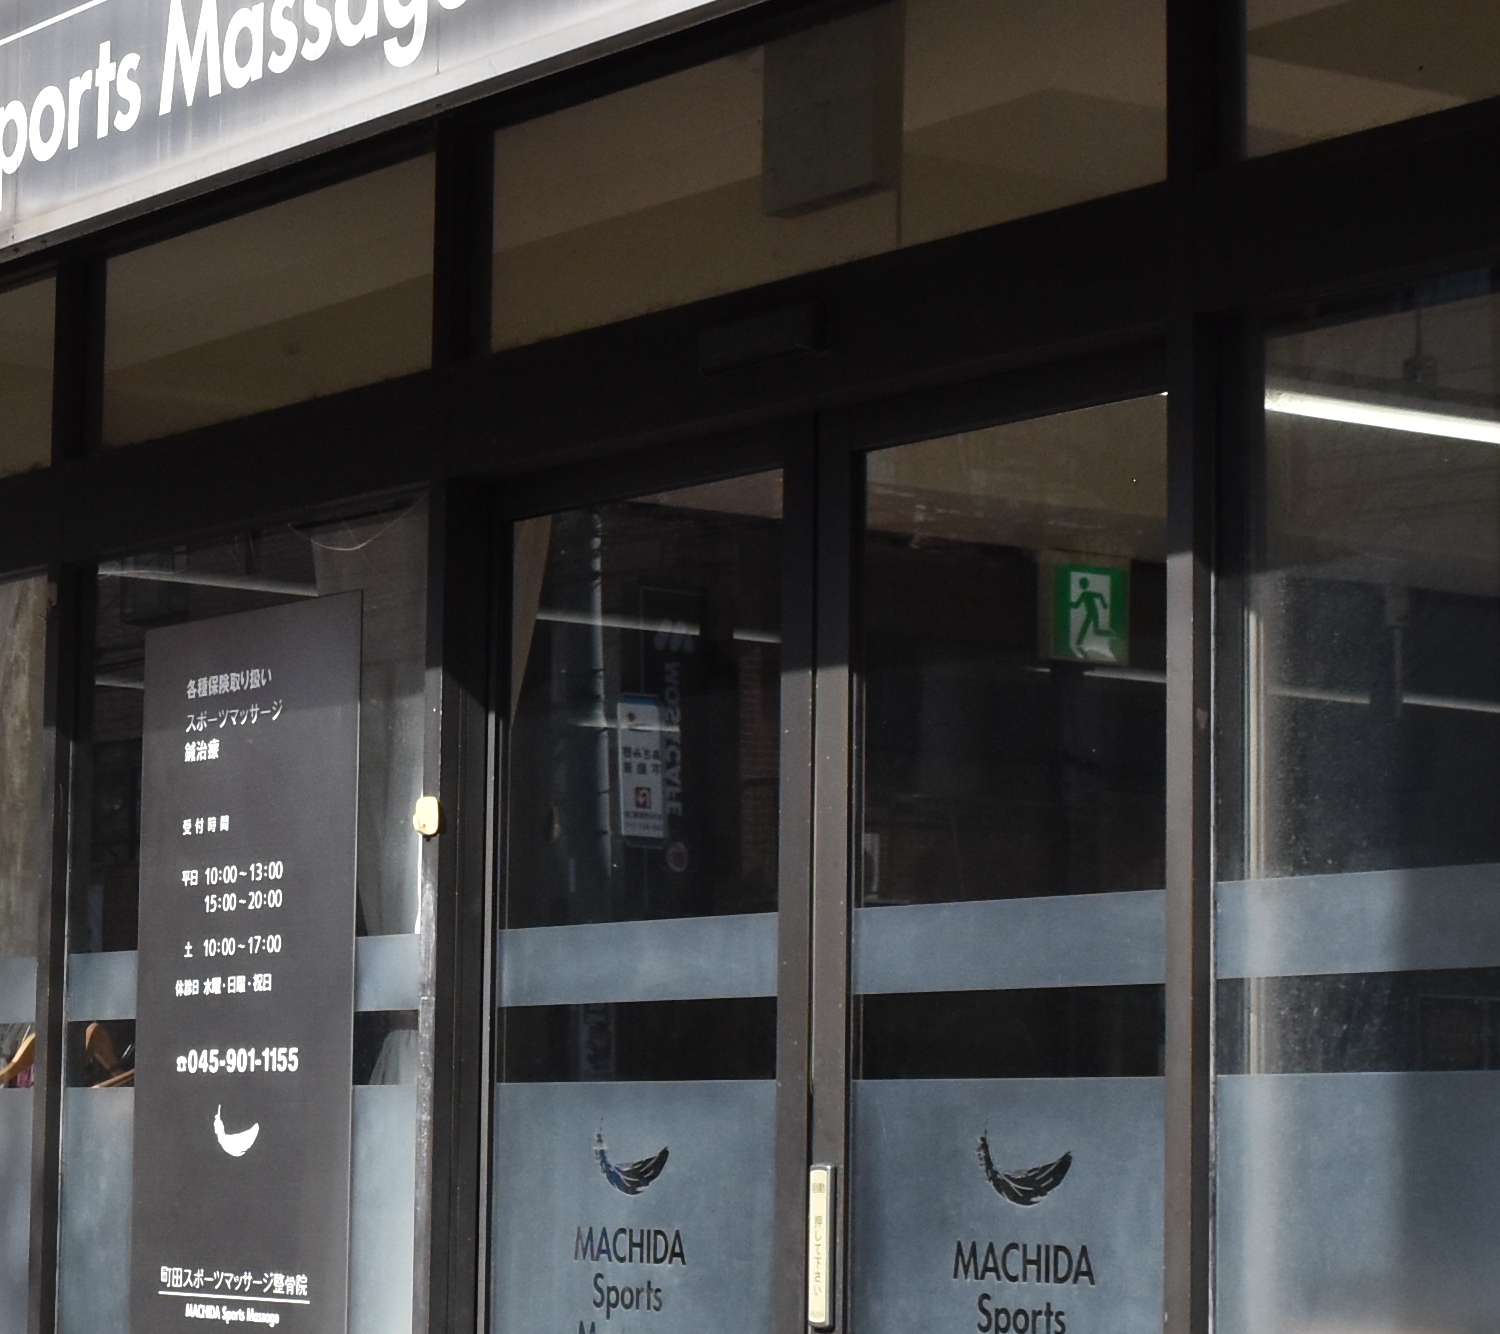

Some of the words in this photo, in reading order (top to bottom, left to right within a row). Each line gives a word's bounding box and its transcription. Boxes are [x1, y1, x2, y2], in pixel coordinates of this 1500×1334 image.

[186, 668, 272, 700] 各種保険取り扱い
[185, 699, 284, 733] スポーツマッサージ
[184, 738, 220, 763] 鍼治療
[182, 815, 230, 836] 受付時間
[181, 869, 199, 887] 平日
[183, 940, 194, 958] 土
[175, 979, 200, 997] 休診日
[187, 1047, 299, 1074] 045-901-1155
[574, 1225, 686, 1267] MACHIDA
[953, 1240, 1095, 1287] MACHIDA
[160, 1265, 308, 1297] 町田スポーツマッサージ整骨院
[592, 1274, 663, 1315] Sports
[184, 1303, 221, 1321] MACHIDA
[222, 1305, 246, 1325] Sports
[246, 1307, 280, 1328] Massage
